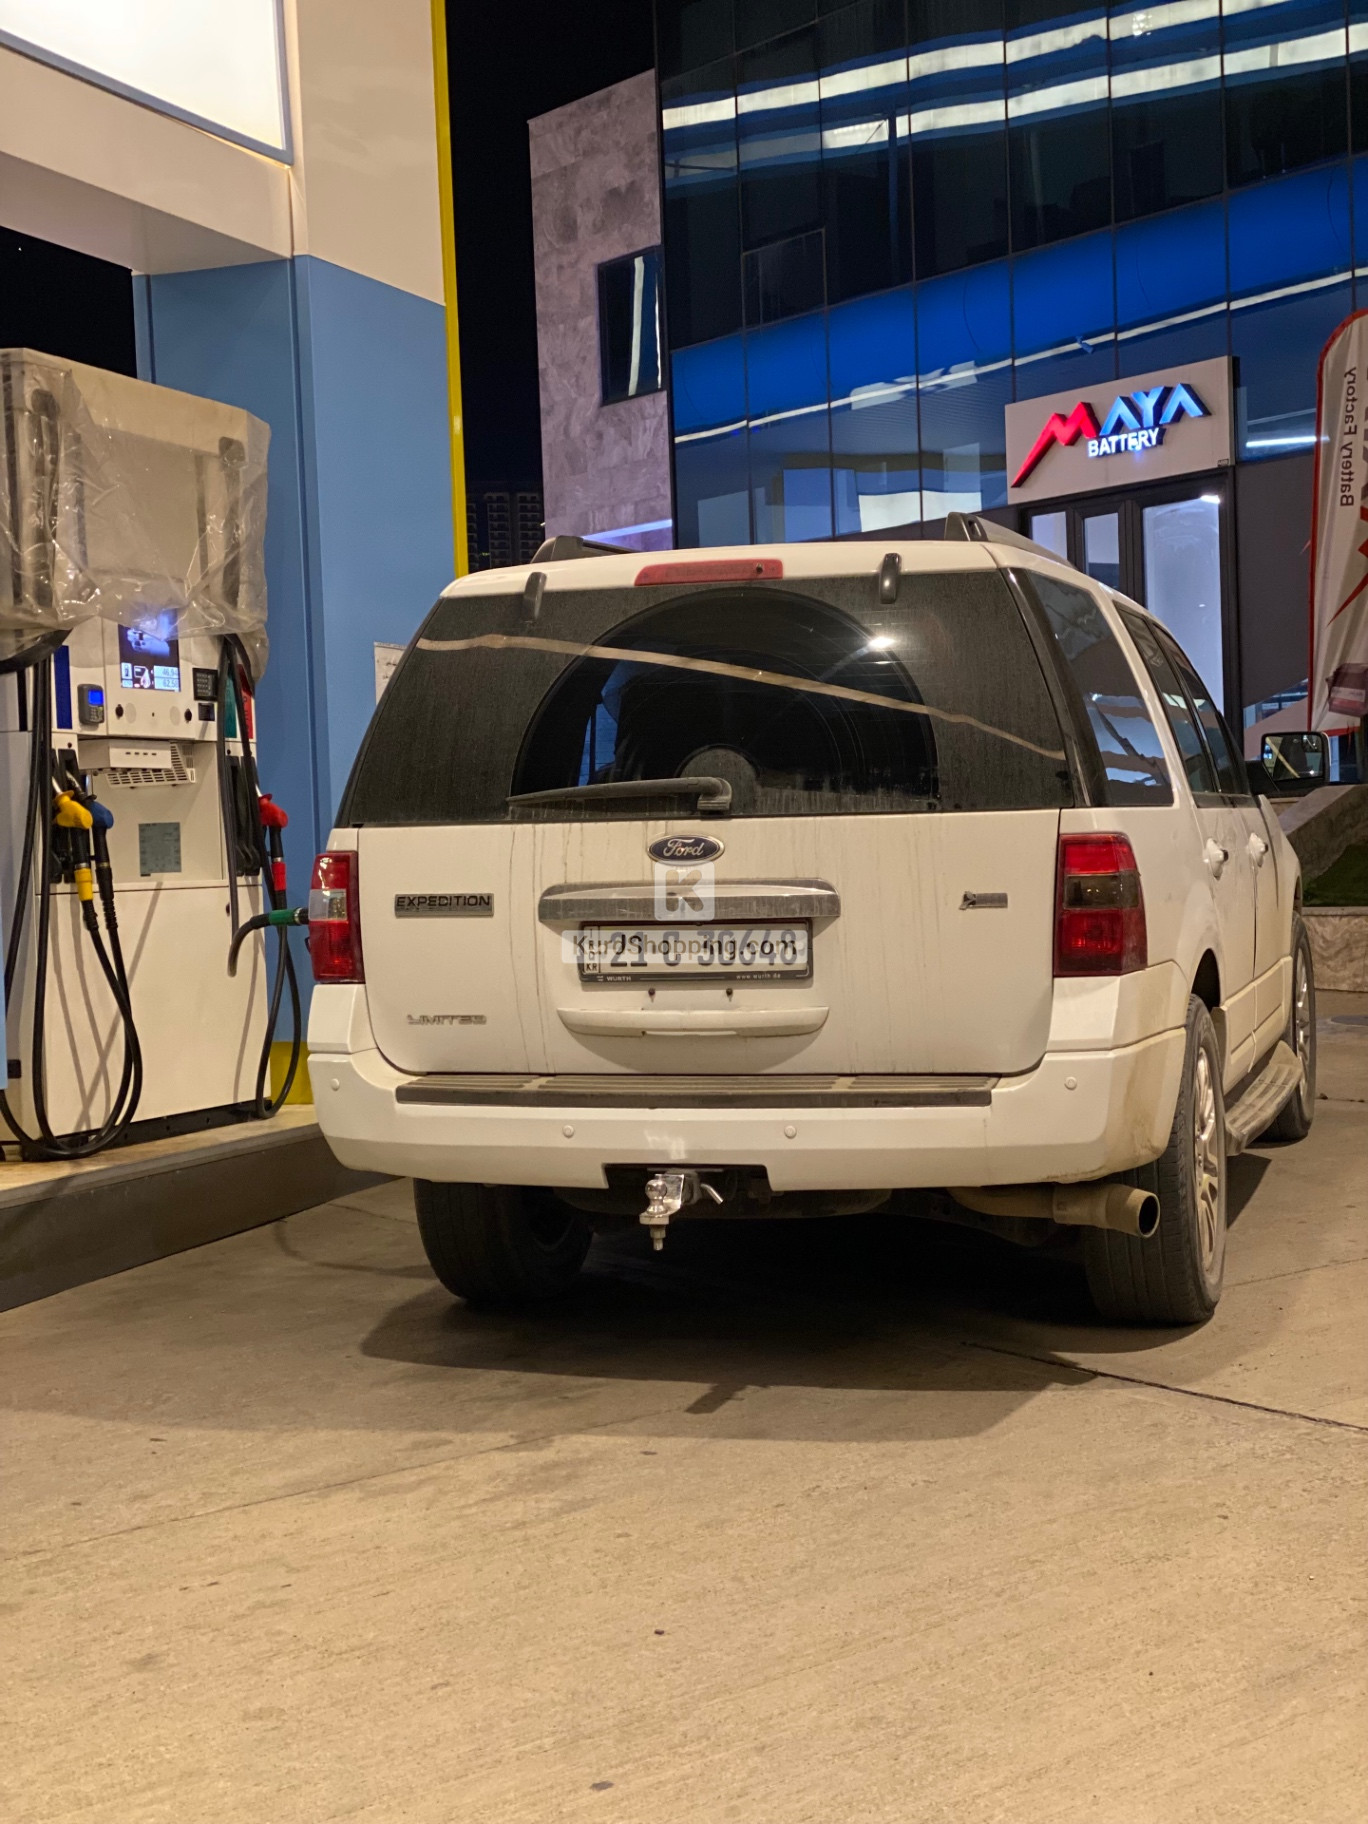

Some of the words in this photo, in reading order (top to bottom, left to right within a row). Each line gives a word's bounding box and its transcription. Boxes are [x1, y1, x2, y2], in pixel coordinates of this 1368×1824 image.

[1011, 382, 1211, 489] MAYA
[1087, 427, 1163, 458] BATTERY
[662, 837, 705, 858] Ford
[396, 895, 491, 908] EXPEDITION
[406, 1014, 488, 1026] LIMITED
